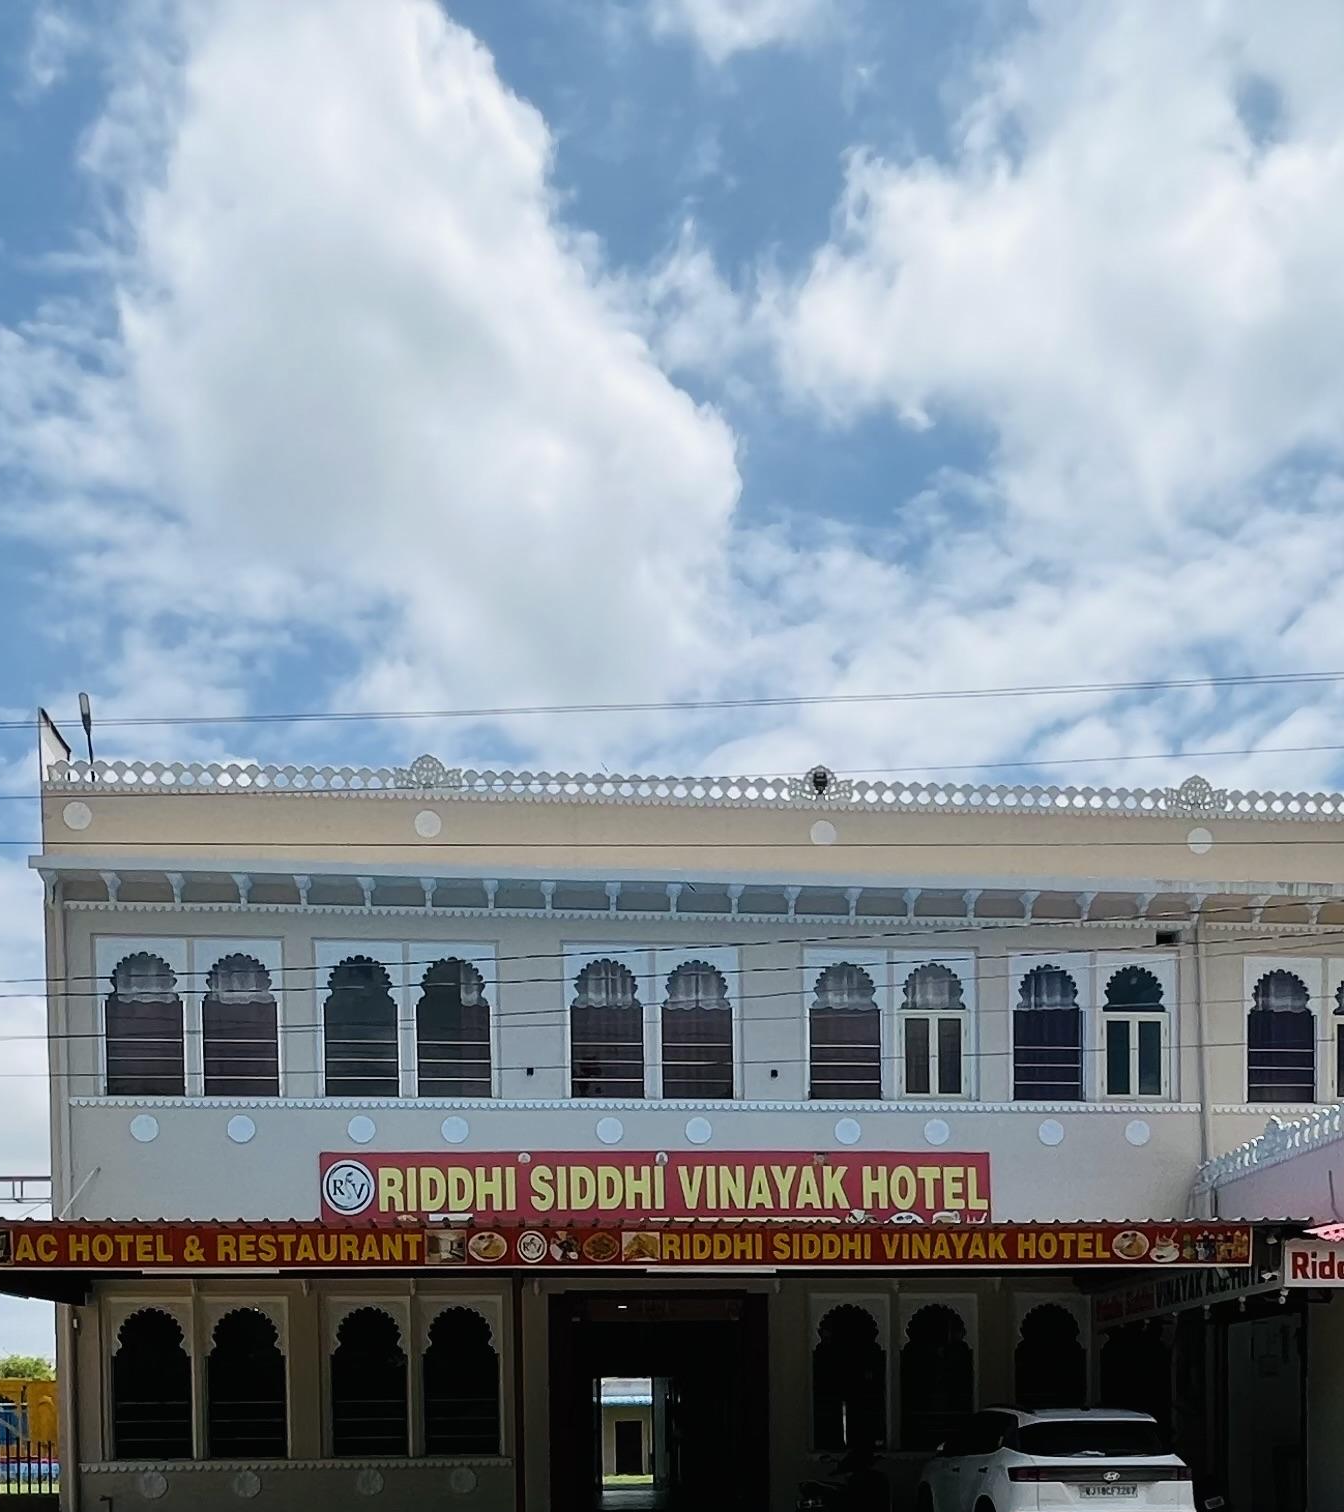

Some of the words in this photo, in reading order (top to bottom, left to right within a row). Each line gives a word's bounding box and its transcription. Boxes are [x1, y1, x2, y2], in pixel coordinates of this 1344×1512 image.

[378, 1166, 517, 1213] RIDDHI
[529, 1165, 665, 1212] SIDDHI
[677, 1165, 850, 1210] VINAYAK
[862, 1165, 989, 1210] HOTEL
[15, 1234, 58, 1263] AC
[69, 1234, 174, 1262] HOTEL
[183, 1235, 206, 1261] &
[217, 1233, 423, 1262] RESTAURANT
[661, 1232, 763, 1261] RIDDHI
[773, 1231, 871, 1261] SIDDHI
[882, 1232, 1008, 1260] VINAYAK
[1017, 1231, 1111, 1260] HOTEL
